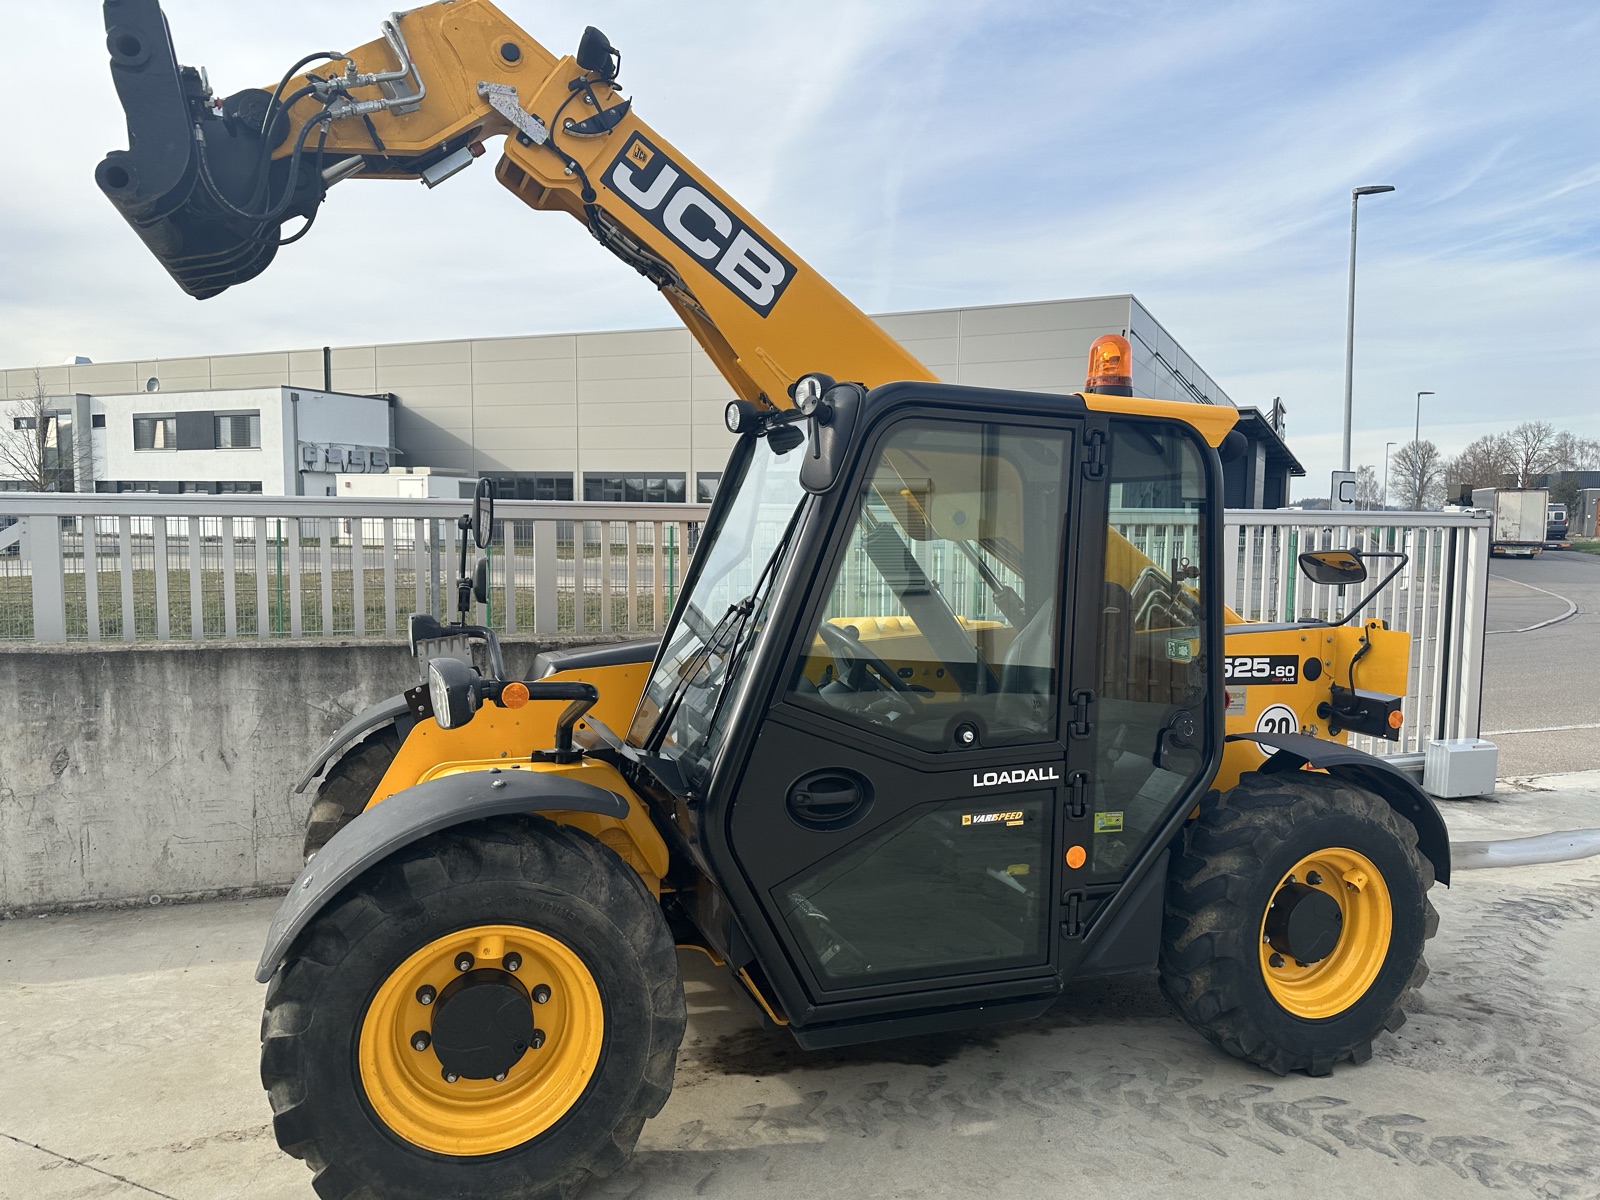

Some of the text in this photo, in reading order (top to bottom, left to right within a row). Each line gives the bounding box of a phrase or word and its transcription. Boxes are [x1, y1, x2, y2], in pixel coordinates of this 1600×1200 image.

[612, 161, 786, 306] JCB
[1264, 717, 1290, 734] 20
[973, 767, 1060, 787] LOADALL
